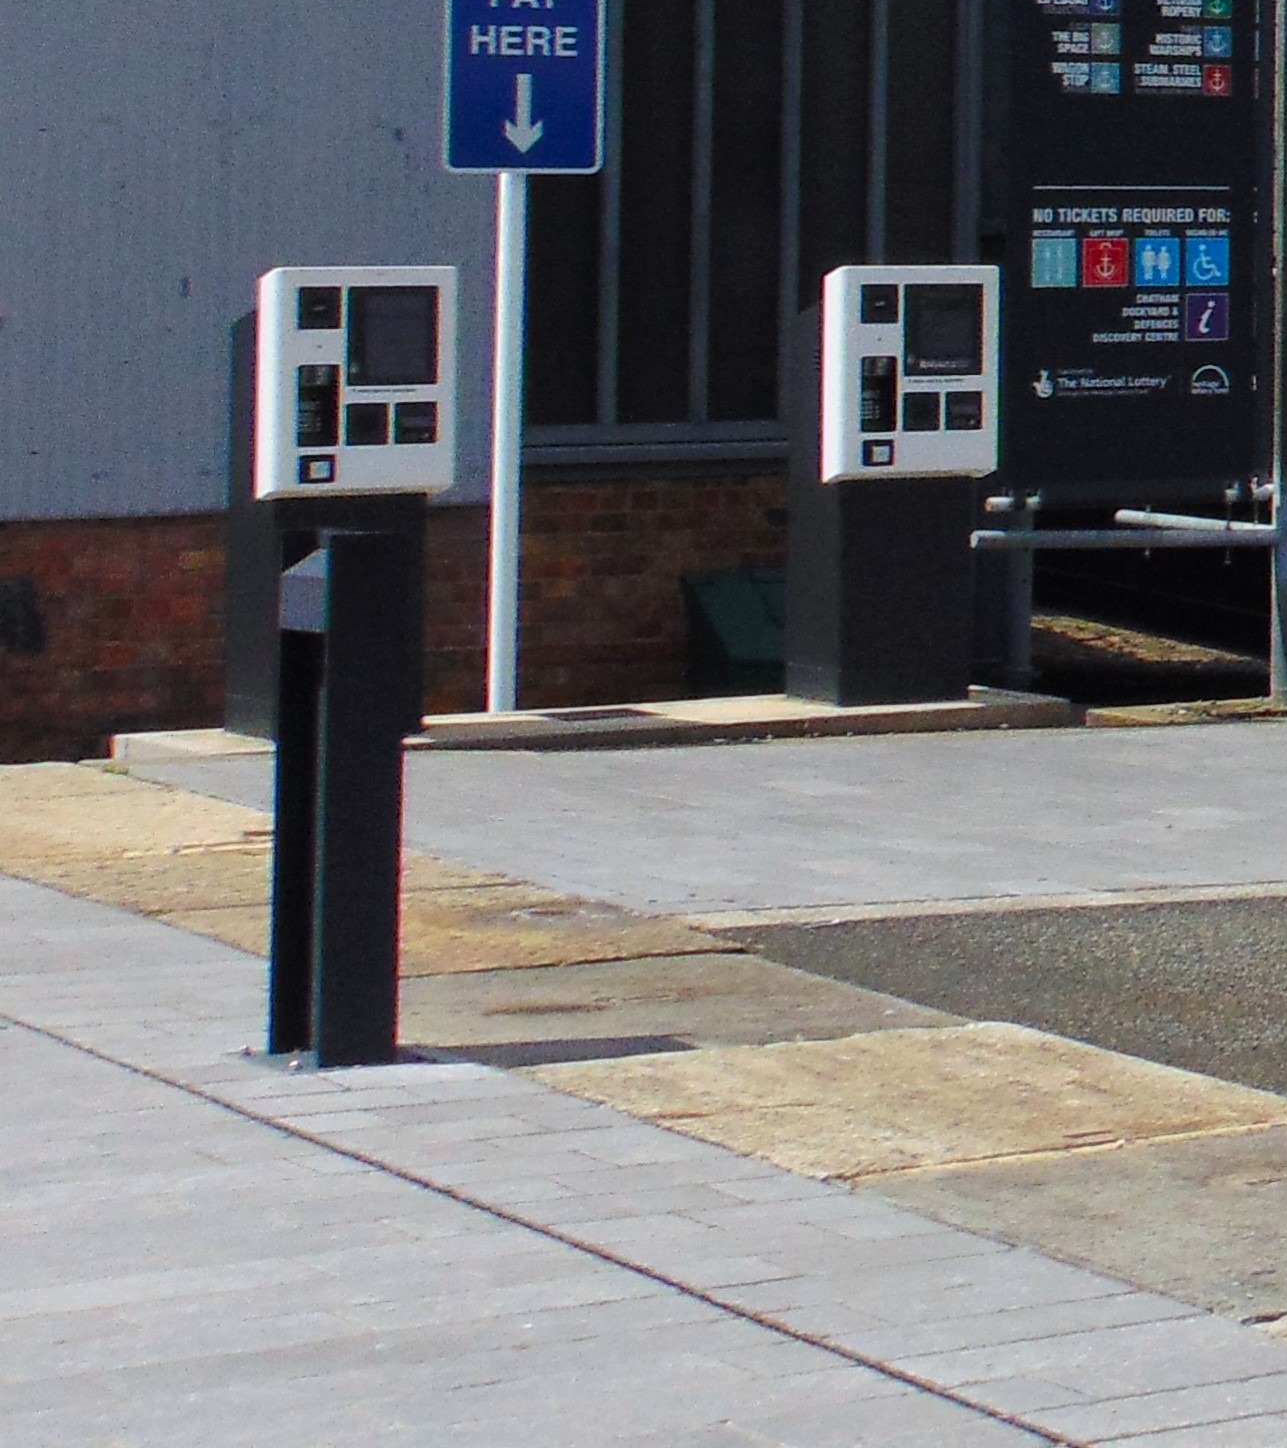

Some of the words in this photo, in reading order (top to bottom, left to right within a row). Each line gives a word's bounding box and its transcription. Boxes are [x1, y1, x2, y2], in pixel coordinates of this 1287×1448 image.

[470, 25, 579, 57] HERE
[1032, 208, 1053, 223] NO
[1058, 208, 1118, 223] TICKETS
[1122, 208, 1194, 224] REQUIRED
[1198, 208, 1231, 223] FOR:
[1058, 377, 1076, 388] The
[1080, 376, 1125, 388] National
[1128, 376, 1167, 389] Lottery
